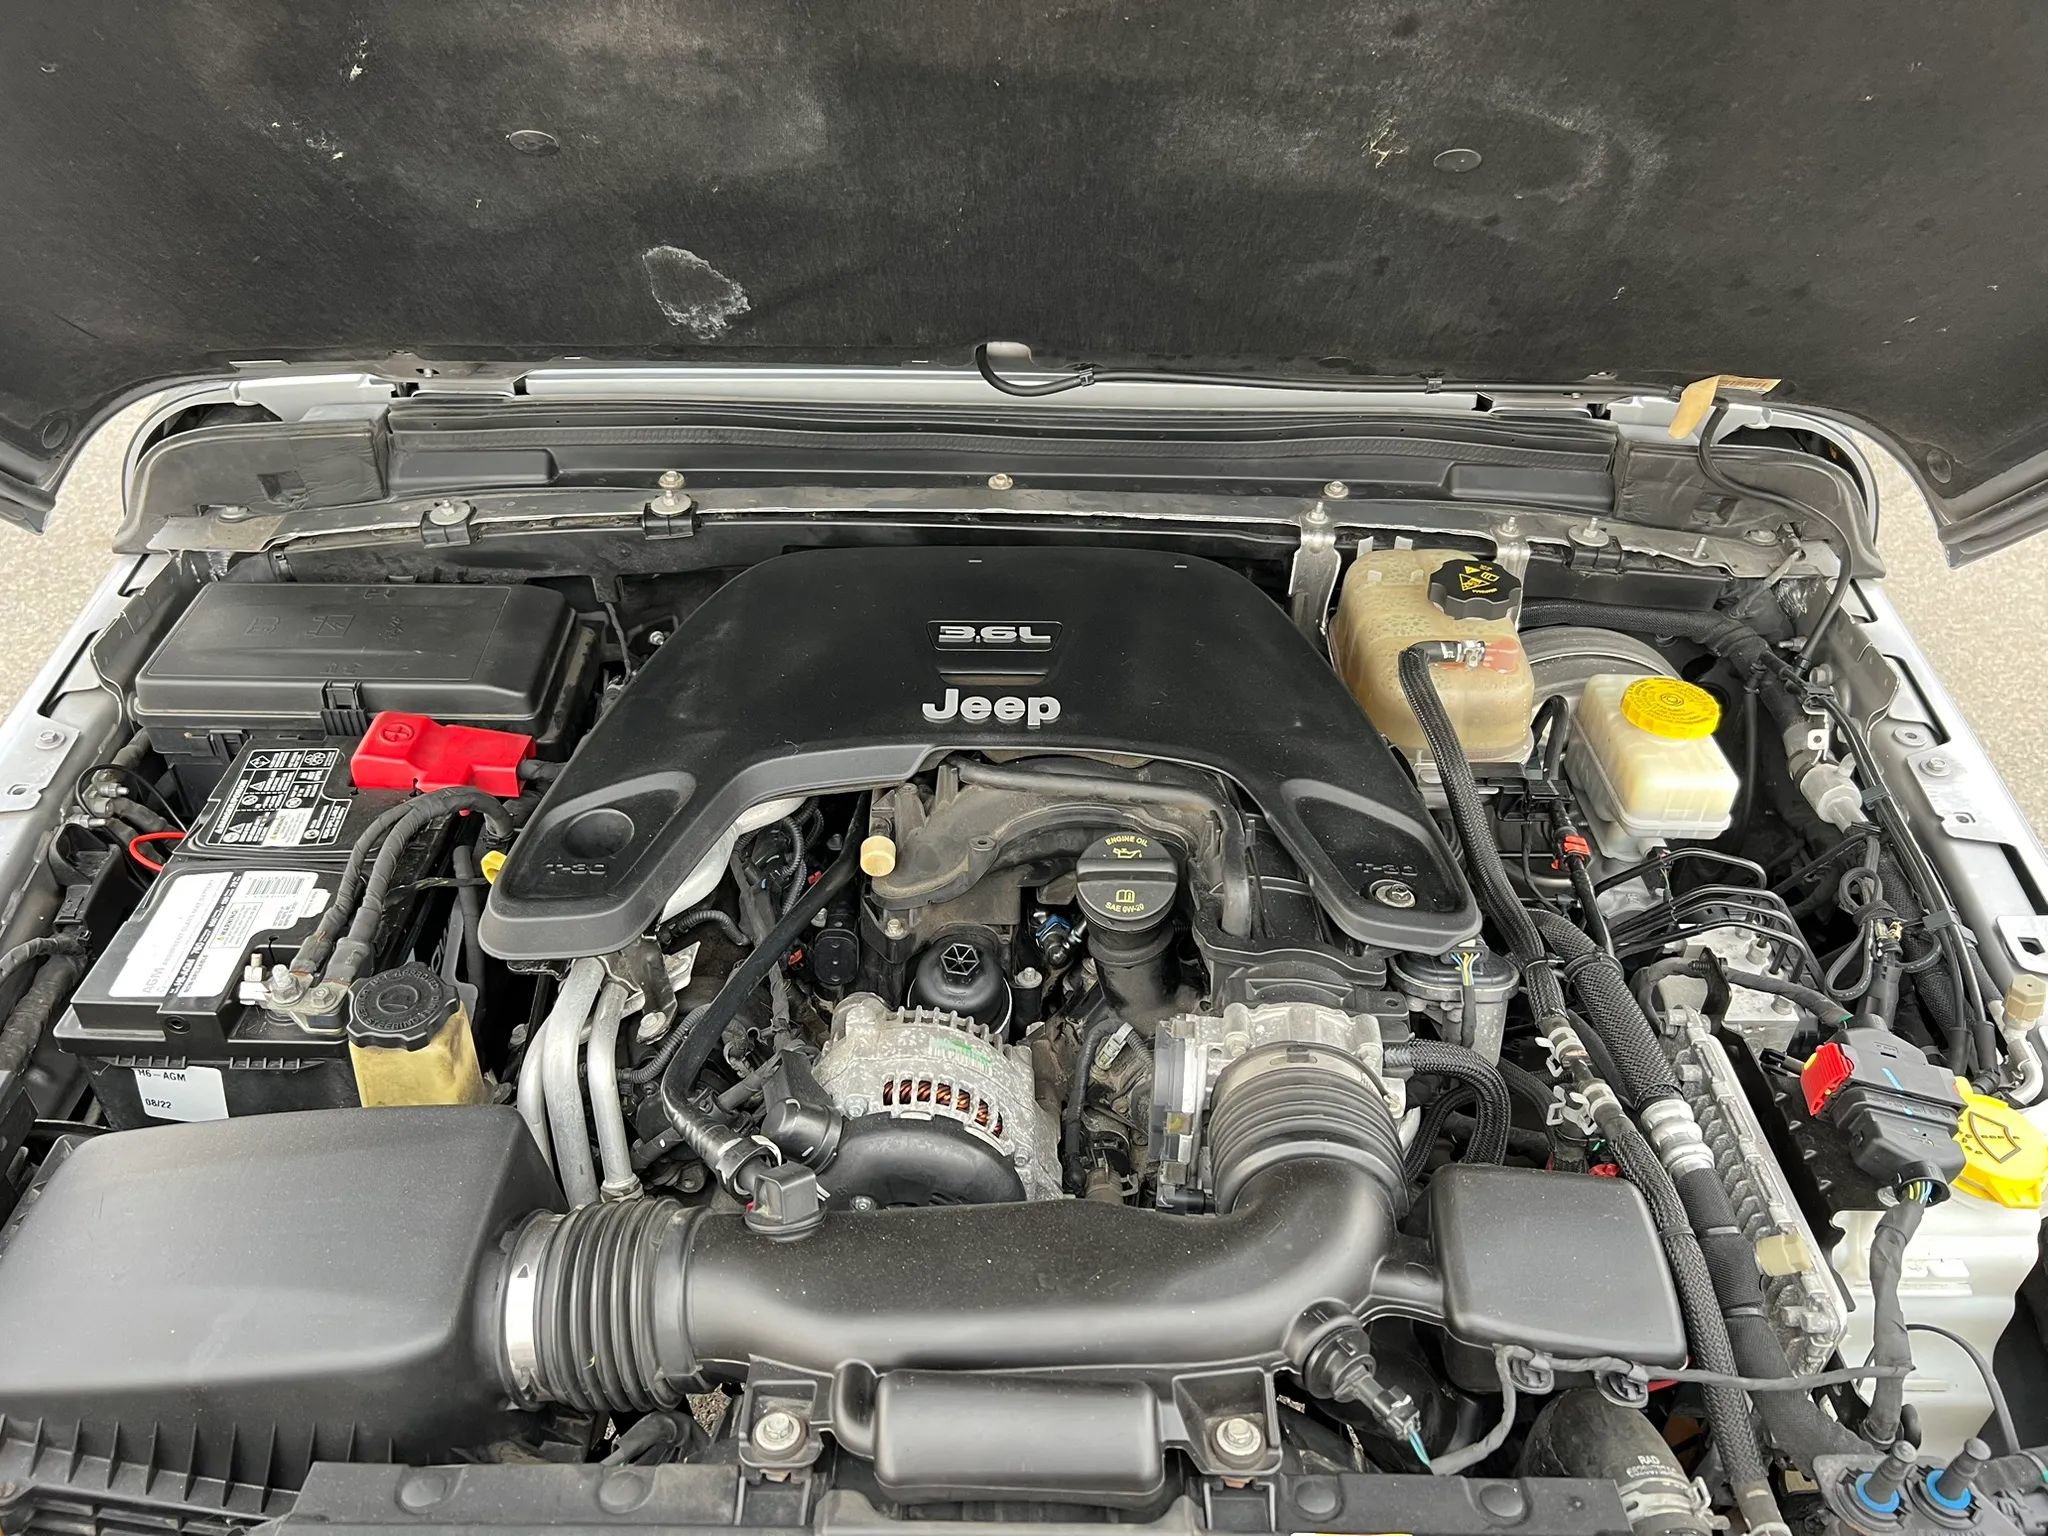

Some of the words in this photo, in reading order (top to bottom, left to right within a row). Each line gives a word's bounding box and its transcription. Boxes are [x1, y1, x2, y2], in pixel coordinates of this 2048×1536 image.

[938, 625, 1051, 643] 3.6L
[922, 688, 1062, 729] Jeep
[1104, 835, 1135, 846] ENGINE
[1136, 837, 1148, 848] OIL
[1105, 901, 1121, 912] SAE
[1122, 903, 1145, 913] 0W-20
[163, 1071, 187, 1081] AGM
[145, 1098, 172, 1109] 08/22
[1637, 1455, 1660, 1465] RAD
